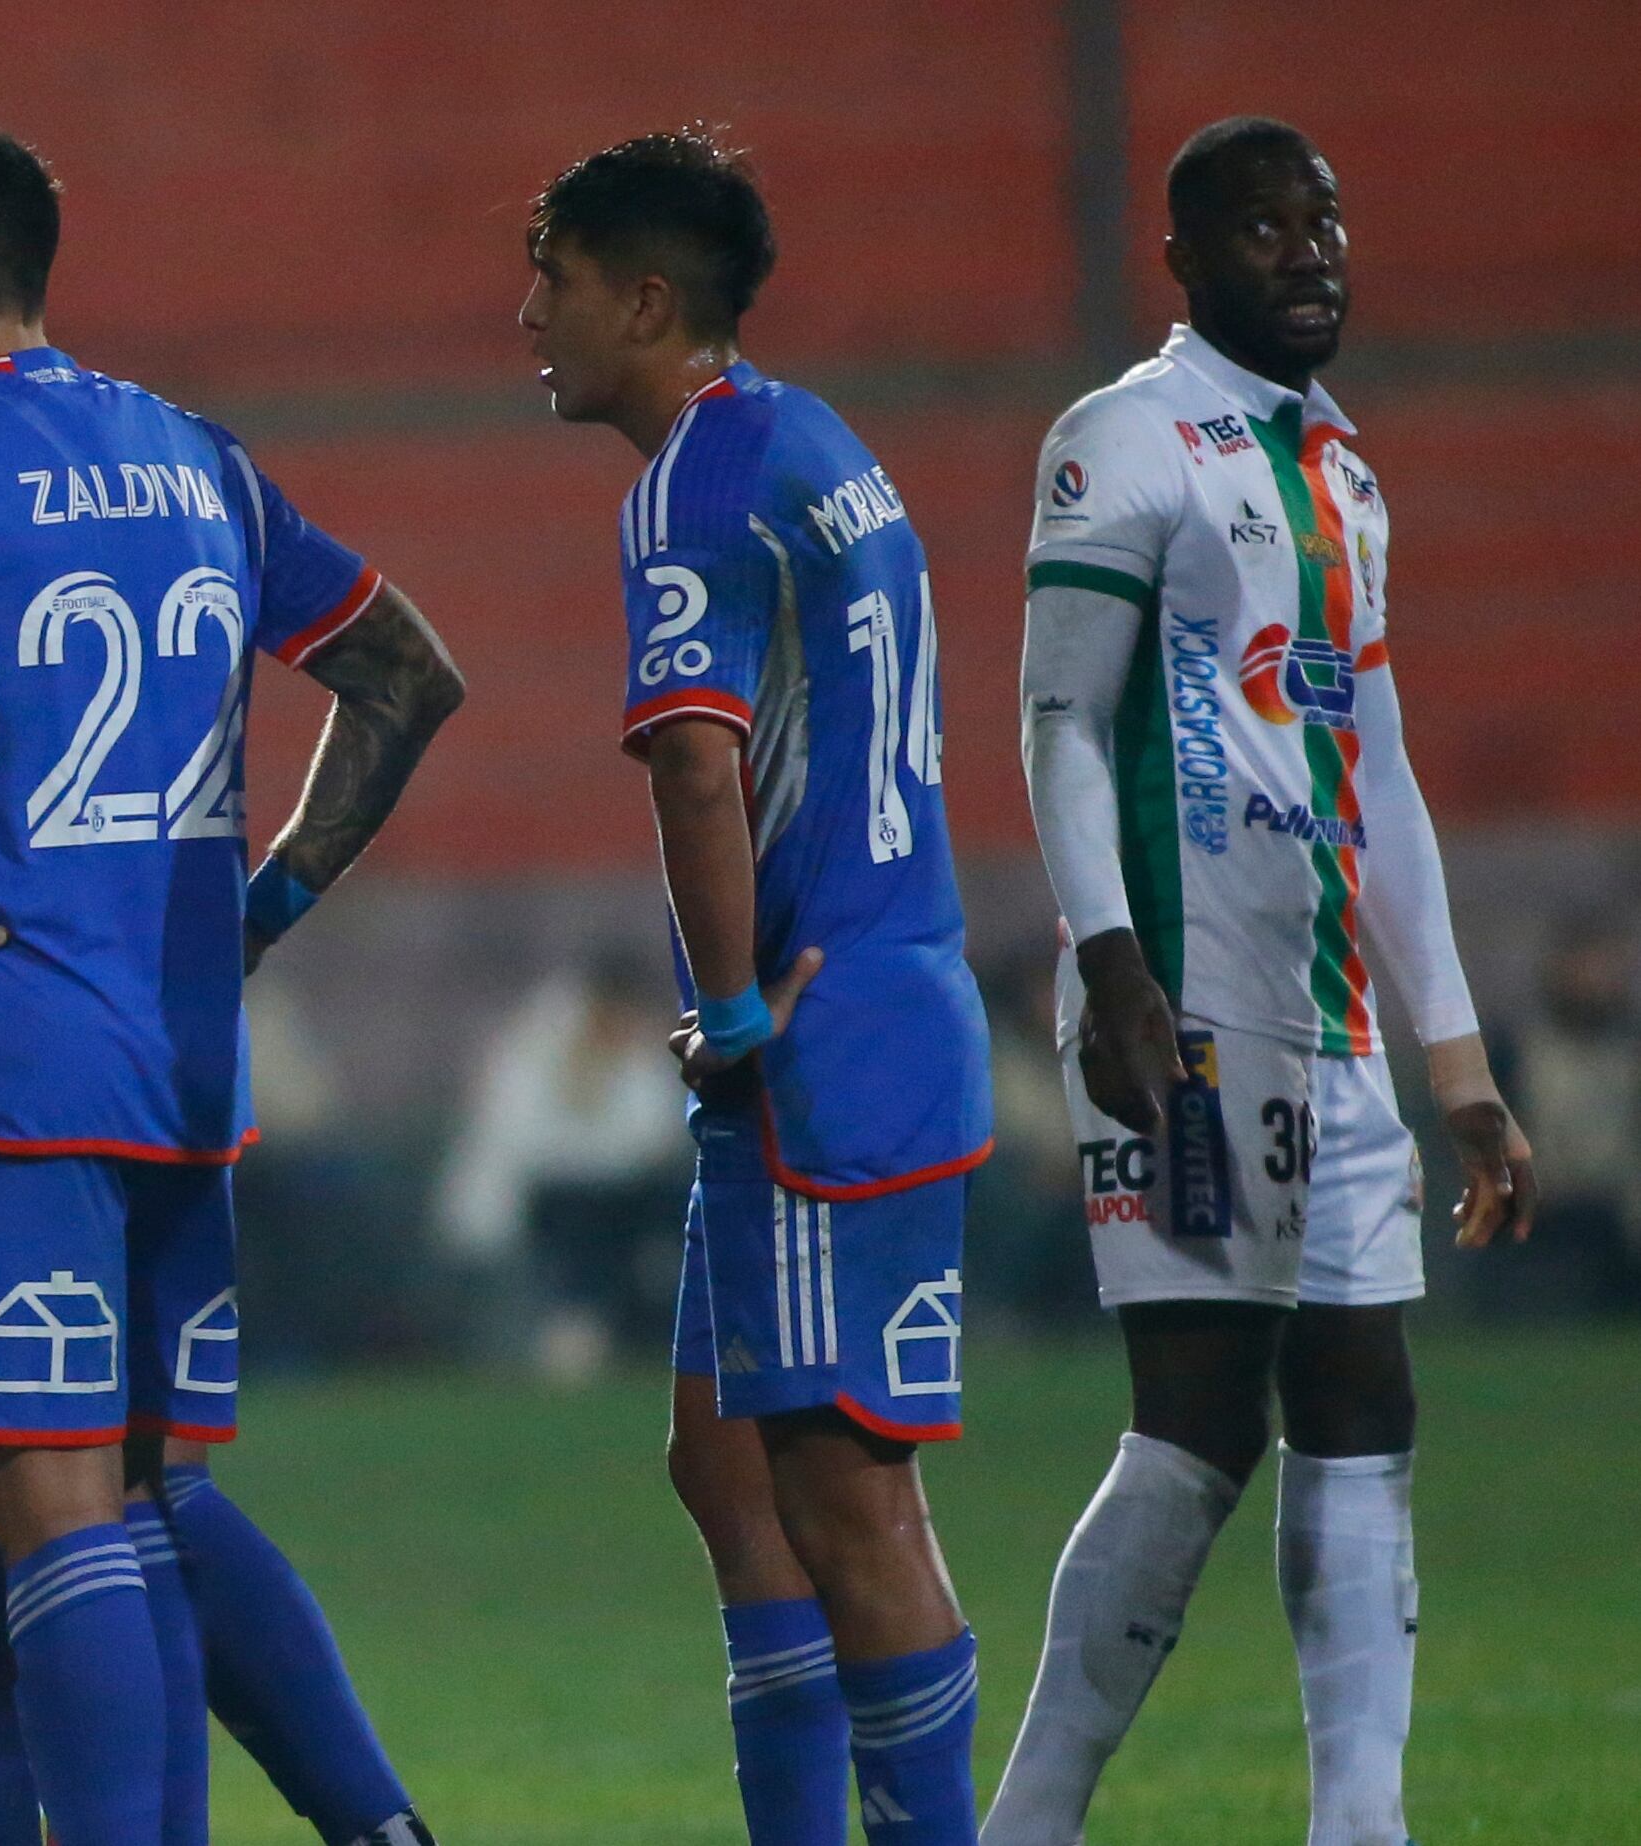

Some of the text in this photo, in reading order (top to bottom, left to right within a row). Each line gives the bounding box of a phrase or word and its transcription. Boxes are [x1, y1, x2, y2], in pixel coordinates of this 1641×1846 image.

[1197, 414, 1245, 443] TEC
[808, 465, 906, 555] MORALE
[1230, 522, 1277, 544] KS7
[639, 640, 713, 685] GO
[18, 566, 245, 848] 22
[1170, 612, 1229, 802] RODASTOCK
[1085, 1193, 1155, 1225] APOL
